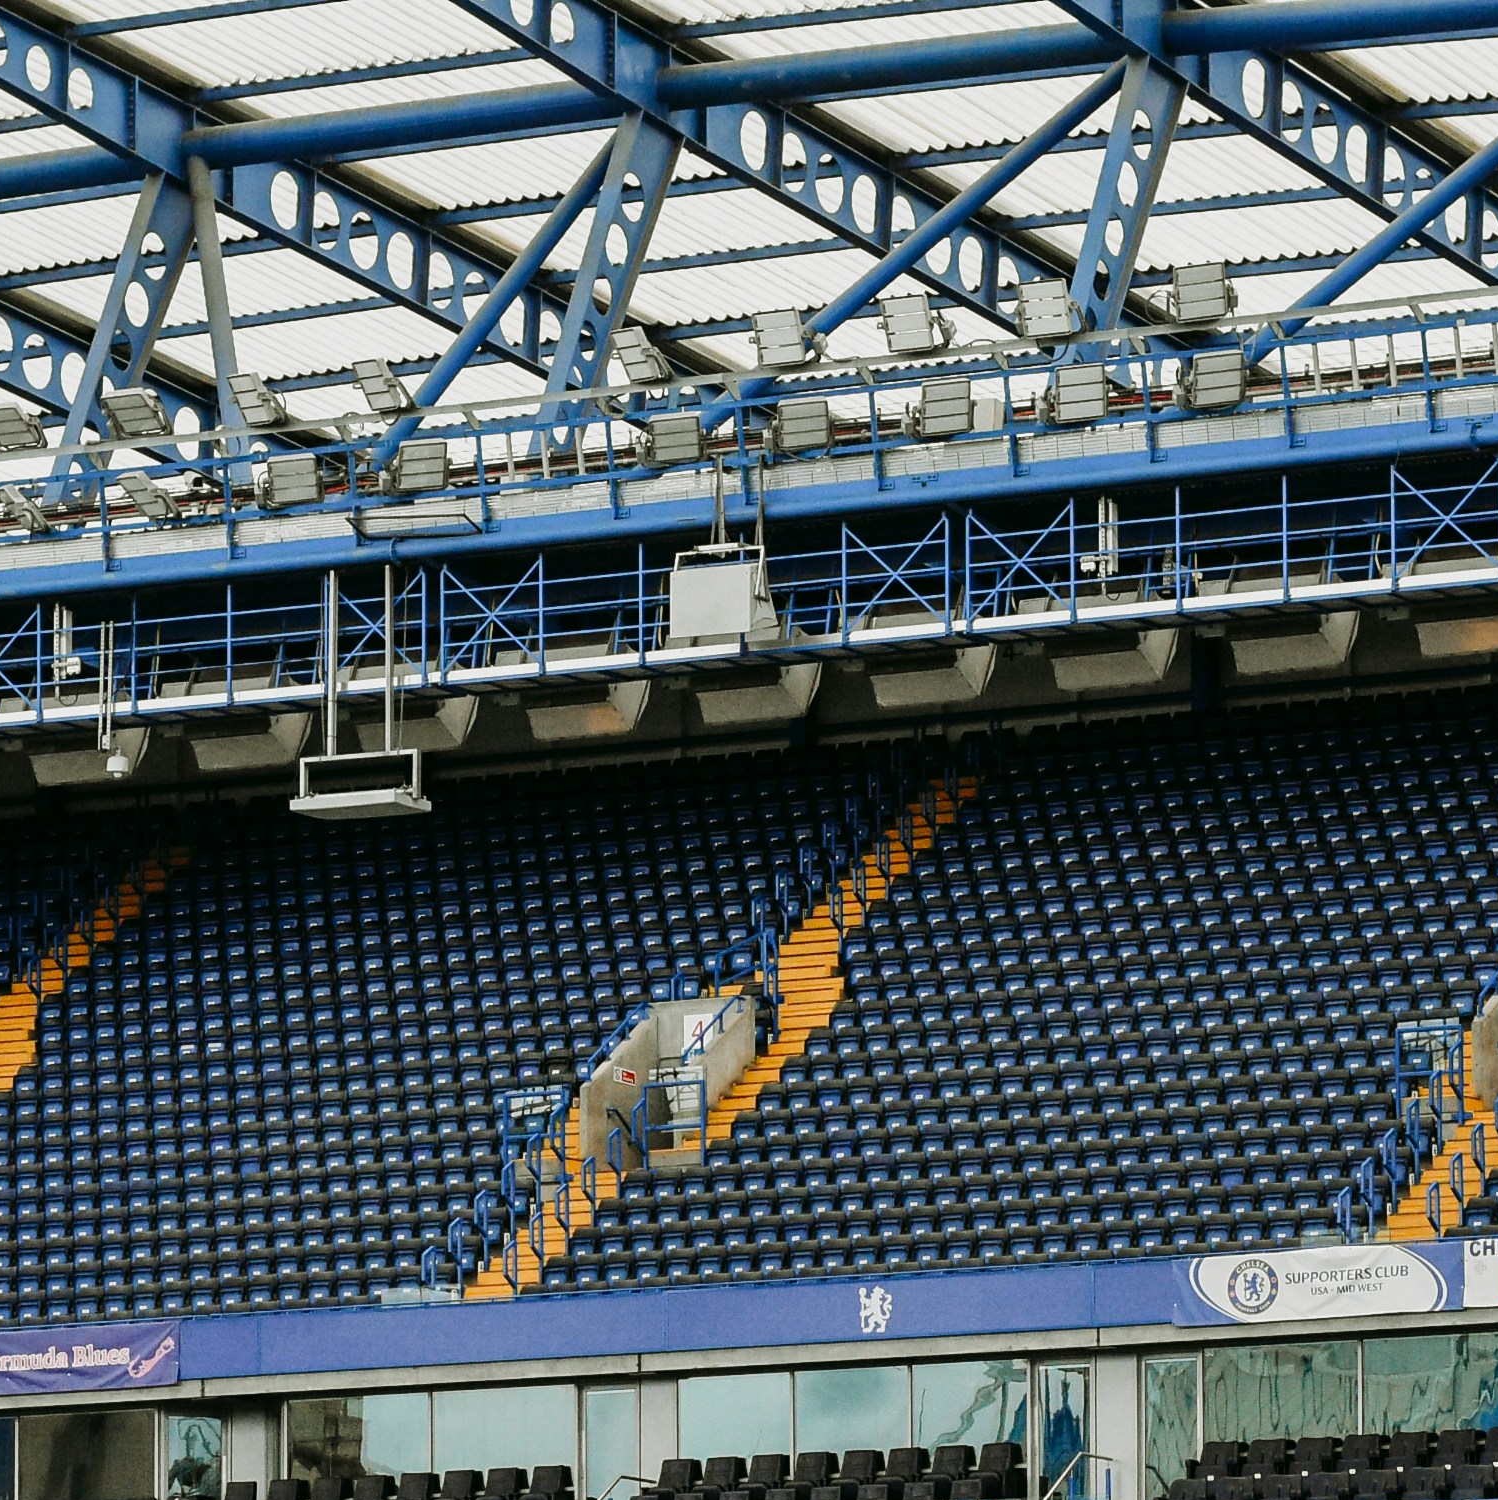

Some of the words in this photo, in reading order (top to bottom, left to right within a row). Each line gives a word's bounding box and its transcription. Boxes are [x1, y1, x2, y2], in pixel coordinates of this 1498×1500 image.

[691, 1020, 703, 1045] 4
[1236, 1260, 1270, 1274] CHELSEA
[1284, 1268, 1372, 1285] SUPPORTERS
[1375, 1265, 1409, 1279] CLUB
[1310, 1286, 1328, 1296] USA
[1336, 1284, 1356, 1294] MID
[1357, 1282, 1383, 1293] WEST
[72, 1346, 130, 1368] Blues
